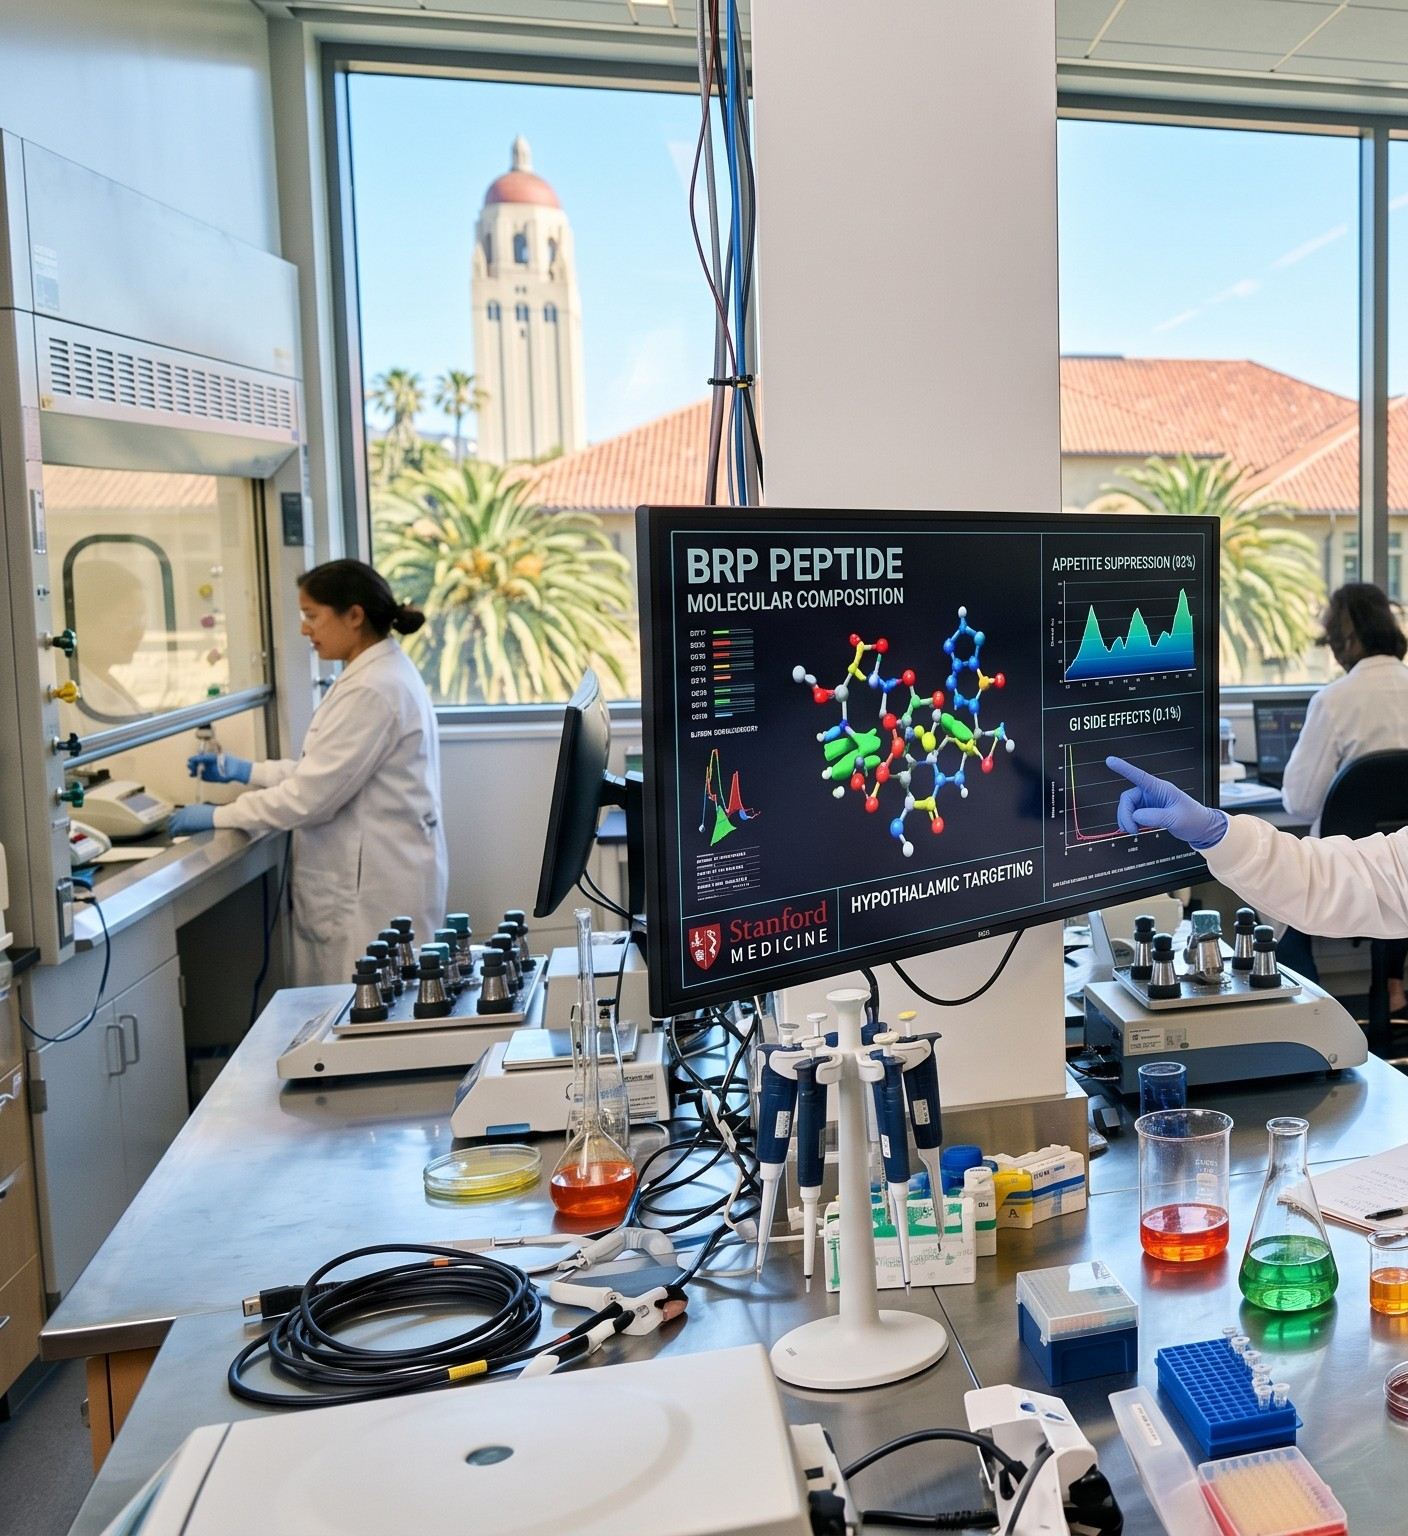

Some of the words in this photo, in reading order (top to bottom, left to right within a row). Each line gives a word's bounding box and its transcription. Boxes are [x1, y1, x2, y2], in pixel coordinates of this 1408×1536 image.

[687, 548, 759, 584] BRP
[769, 547, 904, 582] PEPTIDE
[1052, 556, 1102, 571] APPETITE
[1104, 555, 1171, 570] SUPPRESSION
[687, 591, 793, 613] MOLECULAR
[796, 587, 904, 609] COMPOSITION
[1069, 717, 1081, 731] GI
[1083, 714, 1107, 729] SIDE
[1109, 709, 1151, 727] EFFECTS
[851, 878, 961, 914] HYPOTHALAMIC
[963, 860, 1034, 889] TARGETING
[729, 899, 829, 944] Stanford
[730, 928, 829, 965] MEDICINE
